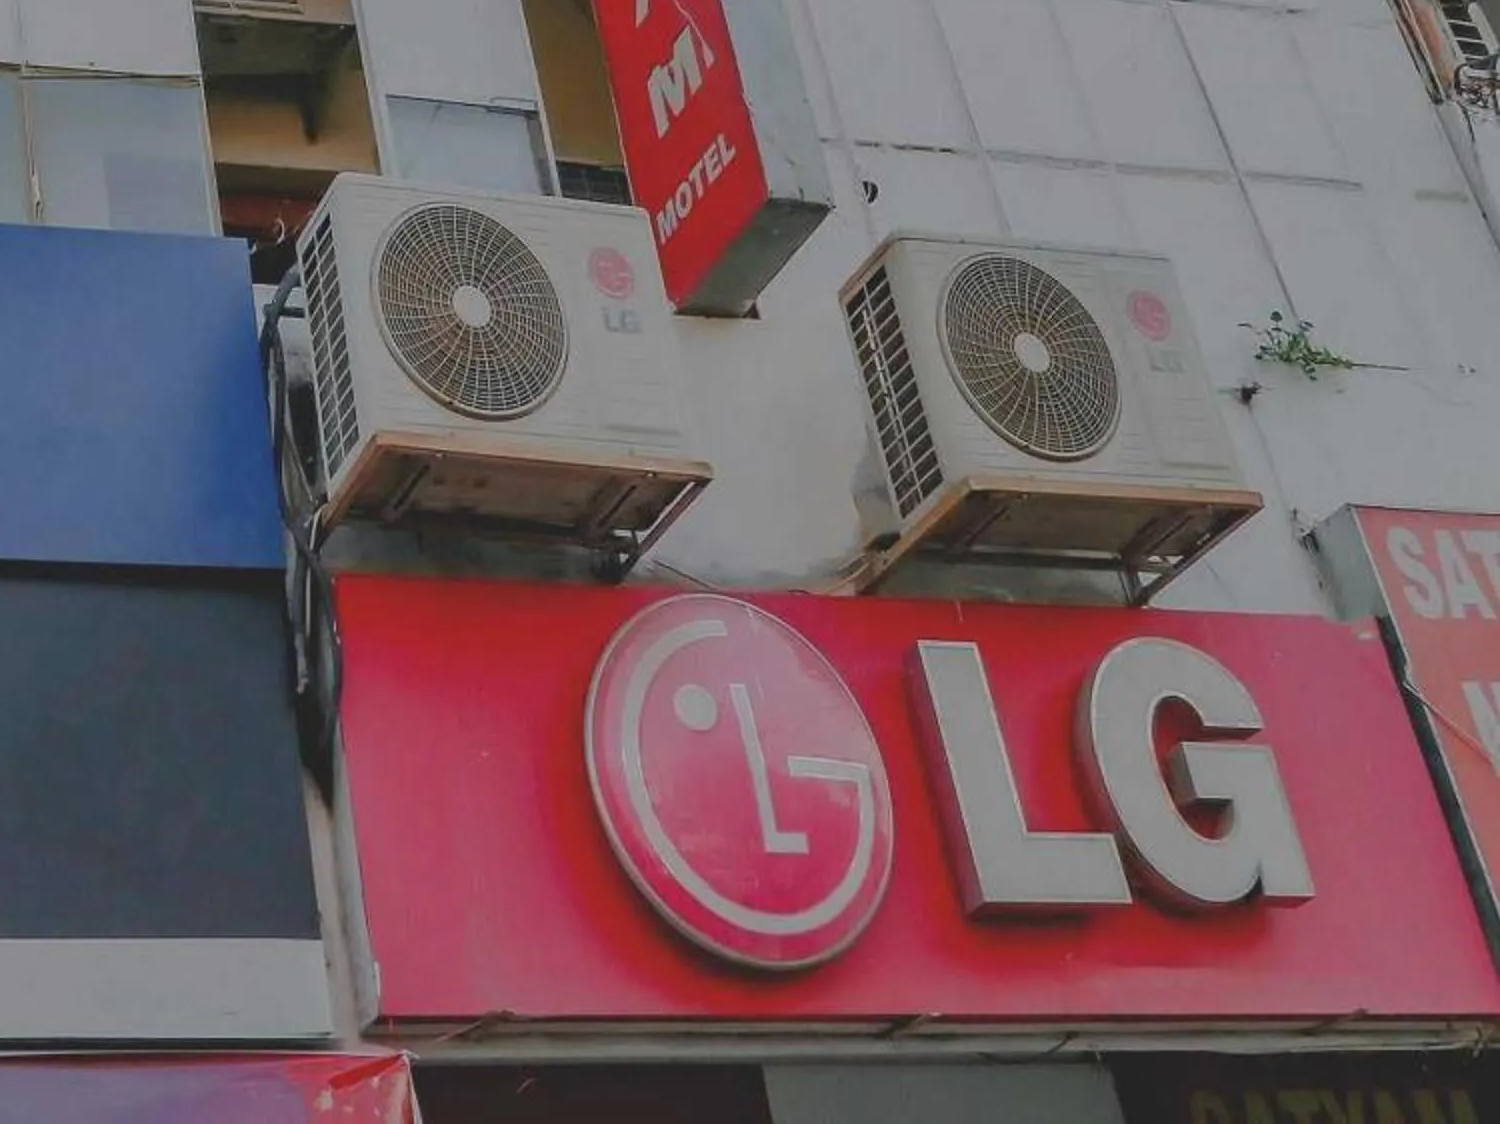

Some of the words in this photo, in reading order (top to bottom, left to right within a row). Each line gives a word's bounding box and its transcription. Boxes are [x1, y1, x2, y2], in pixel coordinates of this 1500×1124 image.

[656, 133, 737, 245] MOTEL
[600, 306, 643, 335] LG
[916, 636, 1316, 914] LG
